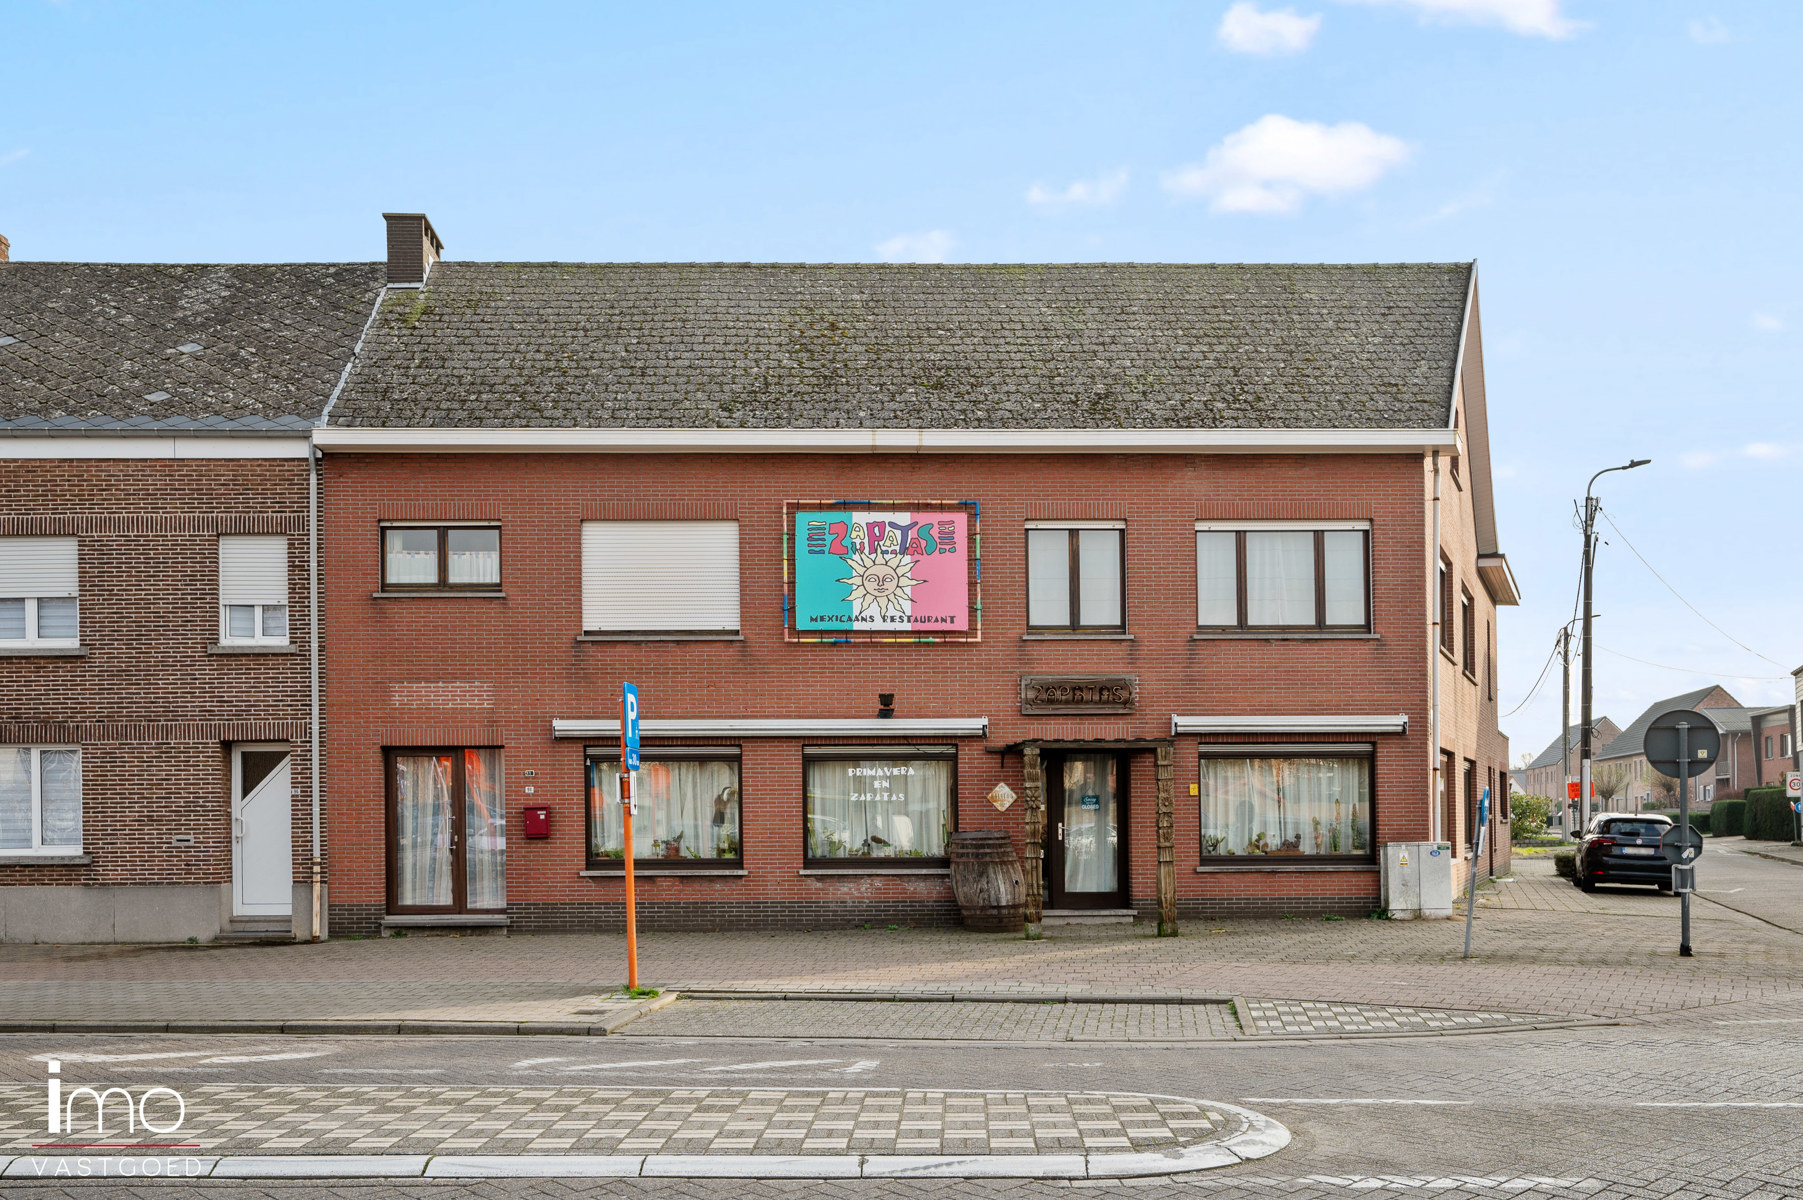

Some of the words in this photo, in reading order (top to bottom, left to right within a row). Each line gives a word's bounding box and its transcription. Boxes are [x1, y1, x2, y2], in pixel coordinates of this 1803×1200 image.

[828, 520, 938, 556] ZAPATAS
[809, 614, 875, 624] MEXICAANS
[882, 615, 956, 625] RESTAURANT
[1032, 685, 1124, 703] ZAPATAS
[627, 692, 638, 738] P
[848, 766, 915, 777] PRIMAVERA
[873, 779, 890, 789] EN
[850, 792, 905, 801] ZAPATAS
